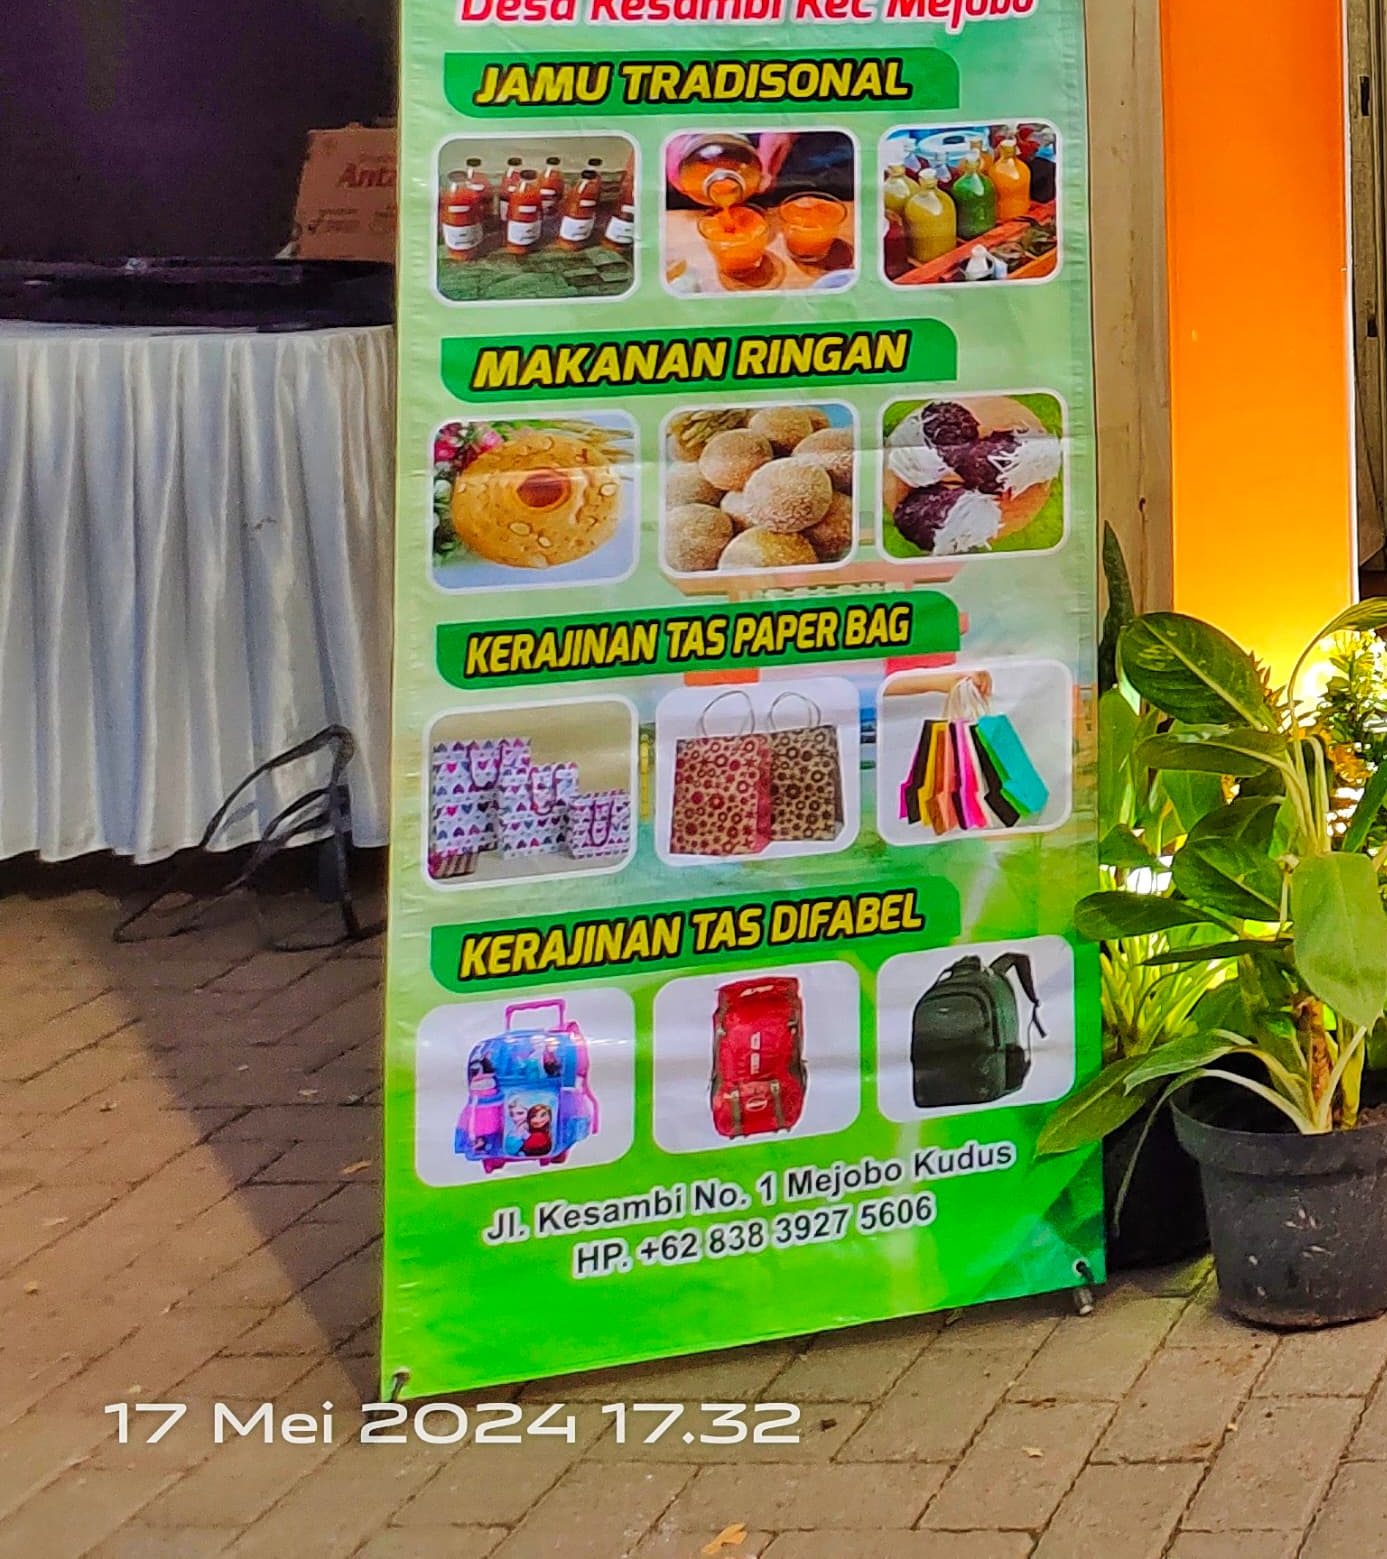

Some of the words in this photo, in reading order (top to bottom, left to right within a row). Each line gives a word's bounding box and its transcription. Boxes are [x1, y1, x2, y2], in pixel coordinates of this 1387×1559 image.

[474, 65, 609, 107] JAMU
[621, 60, 911, 103] TRADISONAL
[470, 338, 728, 390] MAKANAN
[734, 331, 912, 378] RINGAN
[464, 622, 660, 679] KERAJINAN
[665, 615, 728, 661] TAS
[732, 611, 838, 656] PAPER
[844, 604, 912, 648] BAG
[457, 918, 684, 980] KERAJINAN
[691, 905, 767, 953] TAS
[772, 891, 925, 944] DIFABEL
[487, 1208, 529, 1244] Jl.
[537, 1183, 686, 1237] Kesambi
[692, 1178, 749, 1215] No.
[758, 1172, 777, 1206] 1
[788, 1156, 904, 1207] Mejobo
[913, 1141, 1016, 1179] Kudus
[576, 1243, 630, 1277] HP.
[638, 1232, 699, 1264] +62
[708, 1222, 765, 1255] 838
[774, 1208, 849, 1247] 3927
[859, 1195, 936, 1231] 5606
